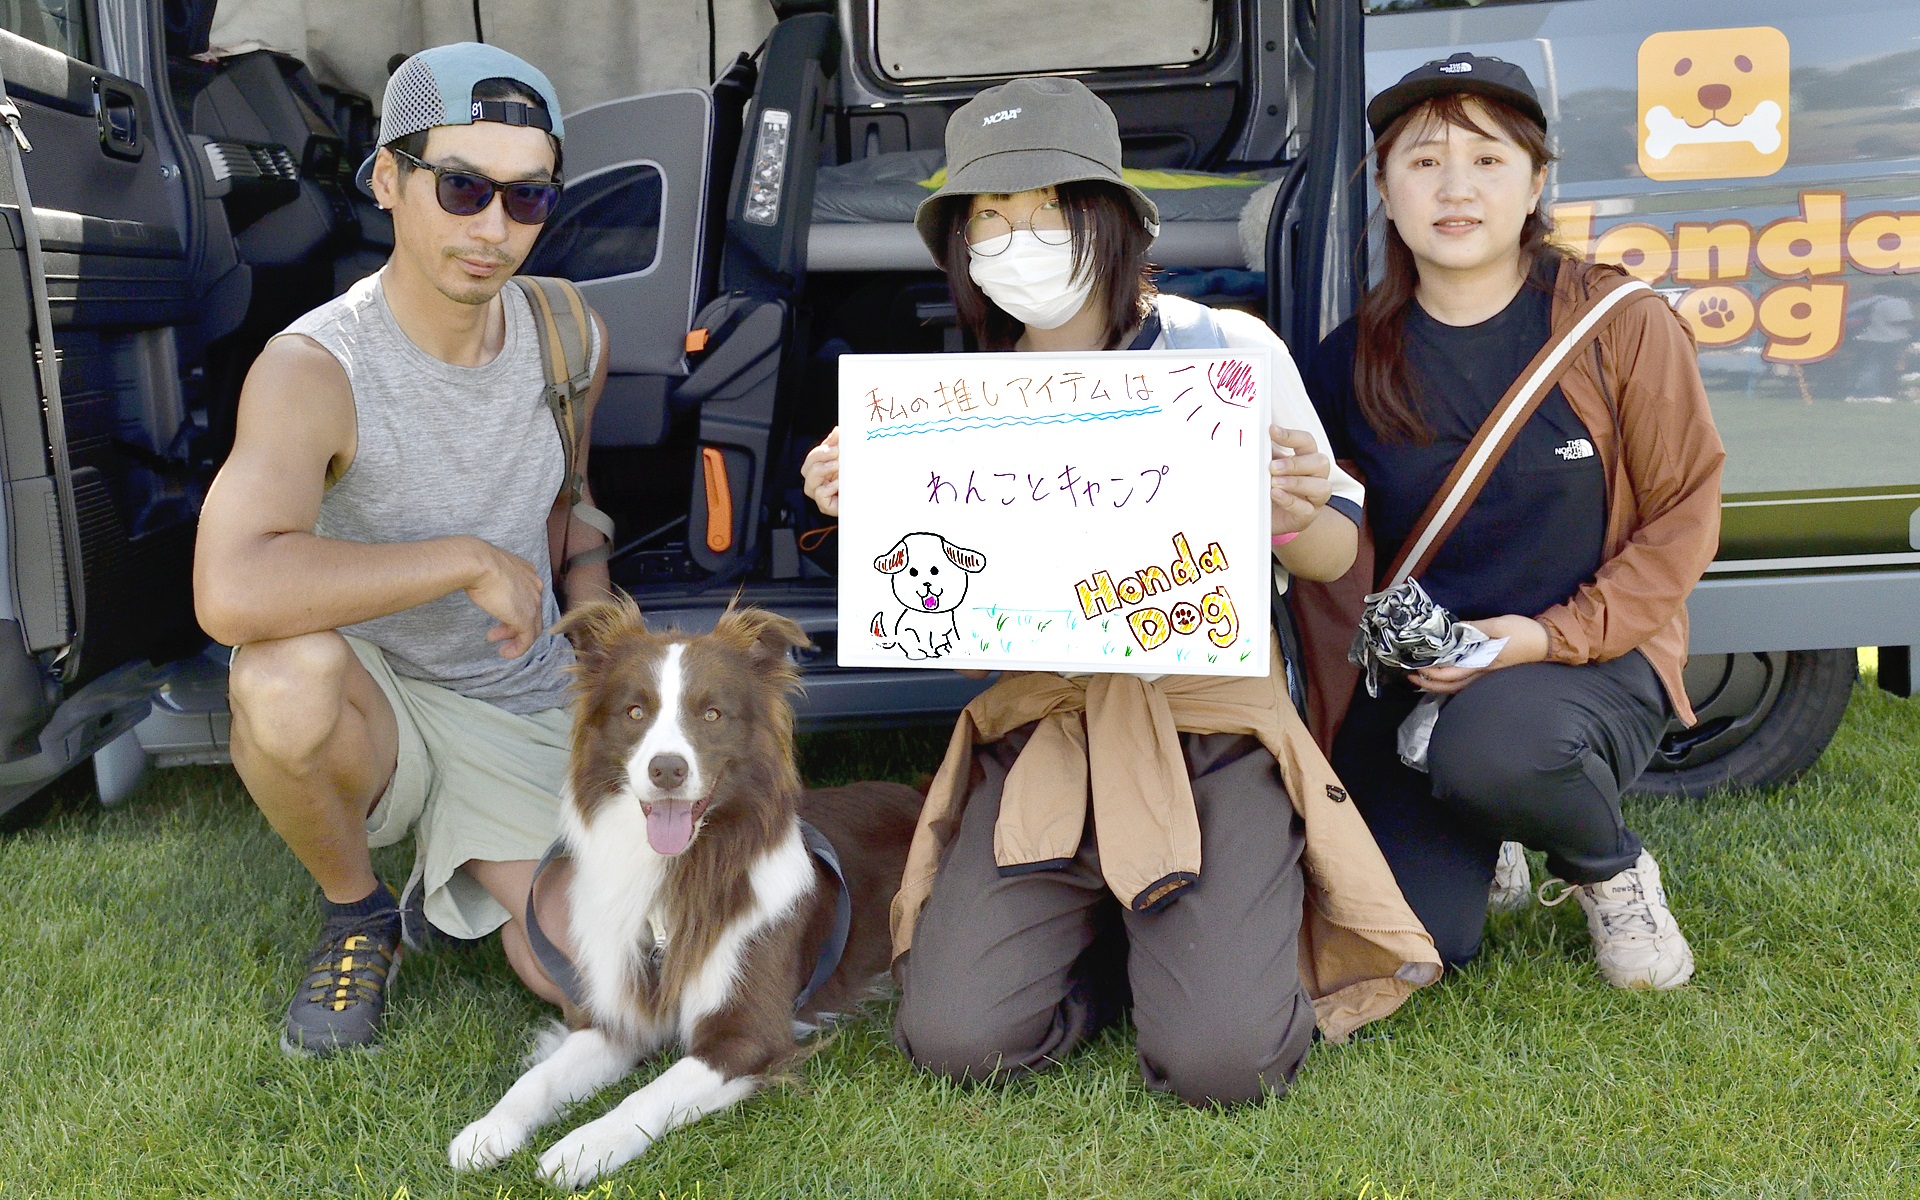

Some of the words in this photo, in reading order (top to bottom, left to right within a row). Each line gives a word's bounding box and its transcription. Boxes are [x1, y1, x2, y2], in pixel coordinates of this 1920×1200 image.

[1674, 279, 1849, 364] og
[865, 372, 1155, 422] 私の推しアイテムは
[1554, 446, 1582, 455] NORTH
[1564, 452, 1582, 460] FACE
[1566, 439, 1581, 448] THE
[926, 465, 1170, 508] わんことキャンプ
[1074, 532, 1229, 620] Honda
[1126, 585, 1239, 652] Dog
